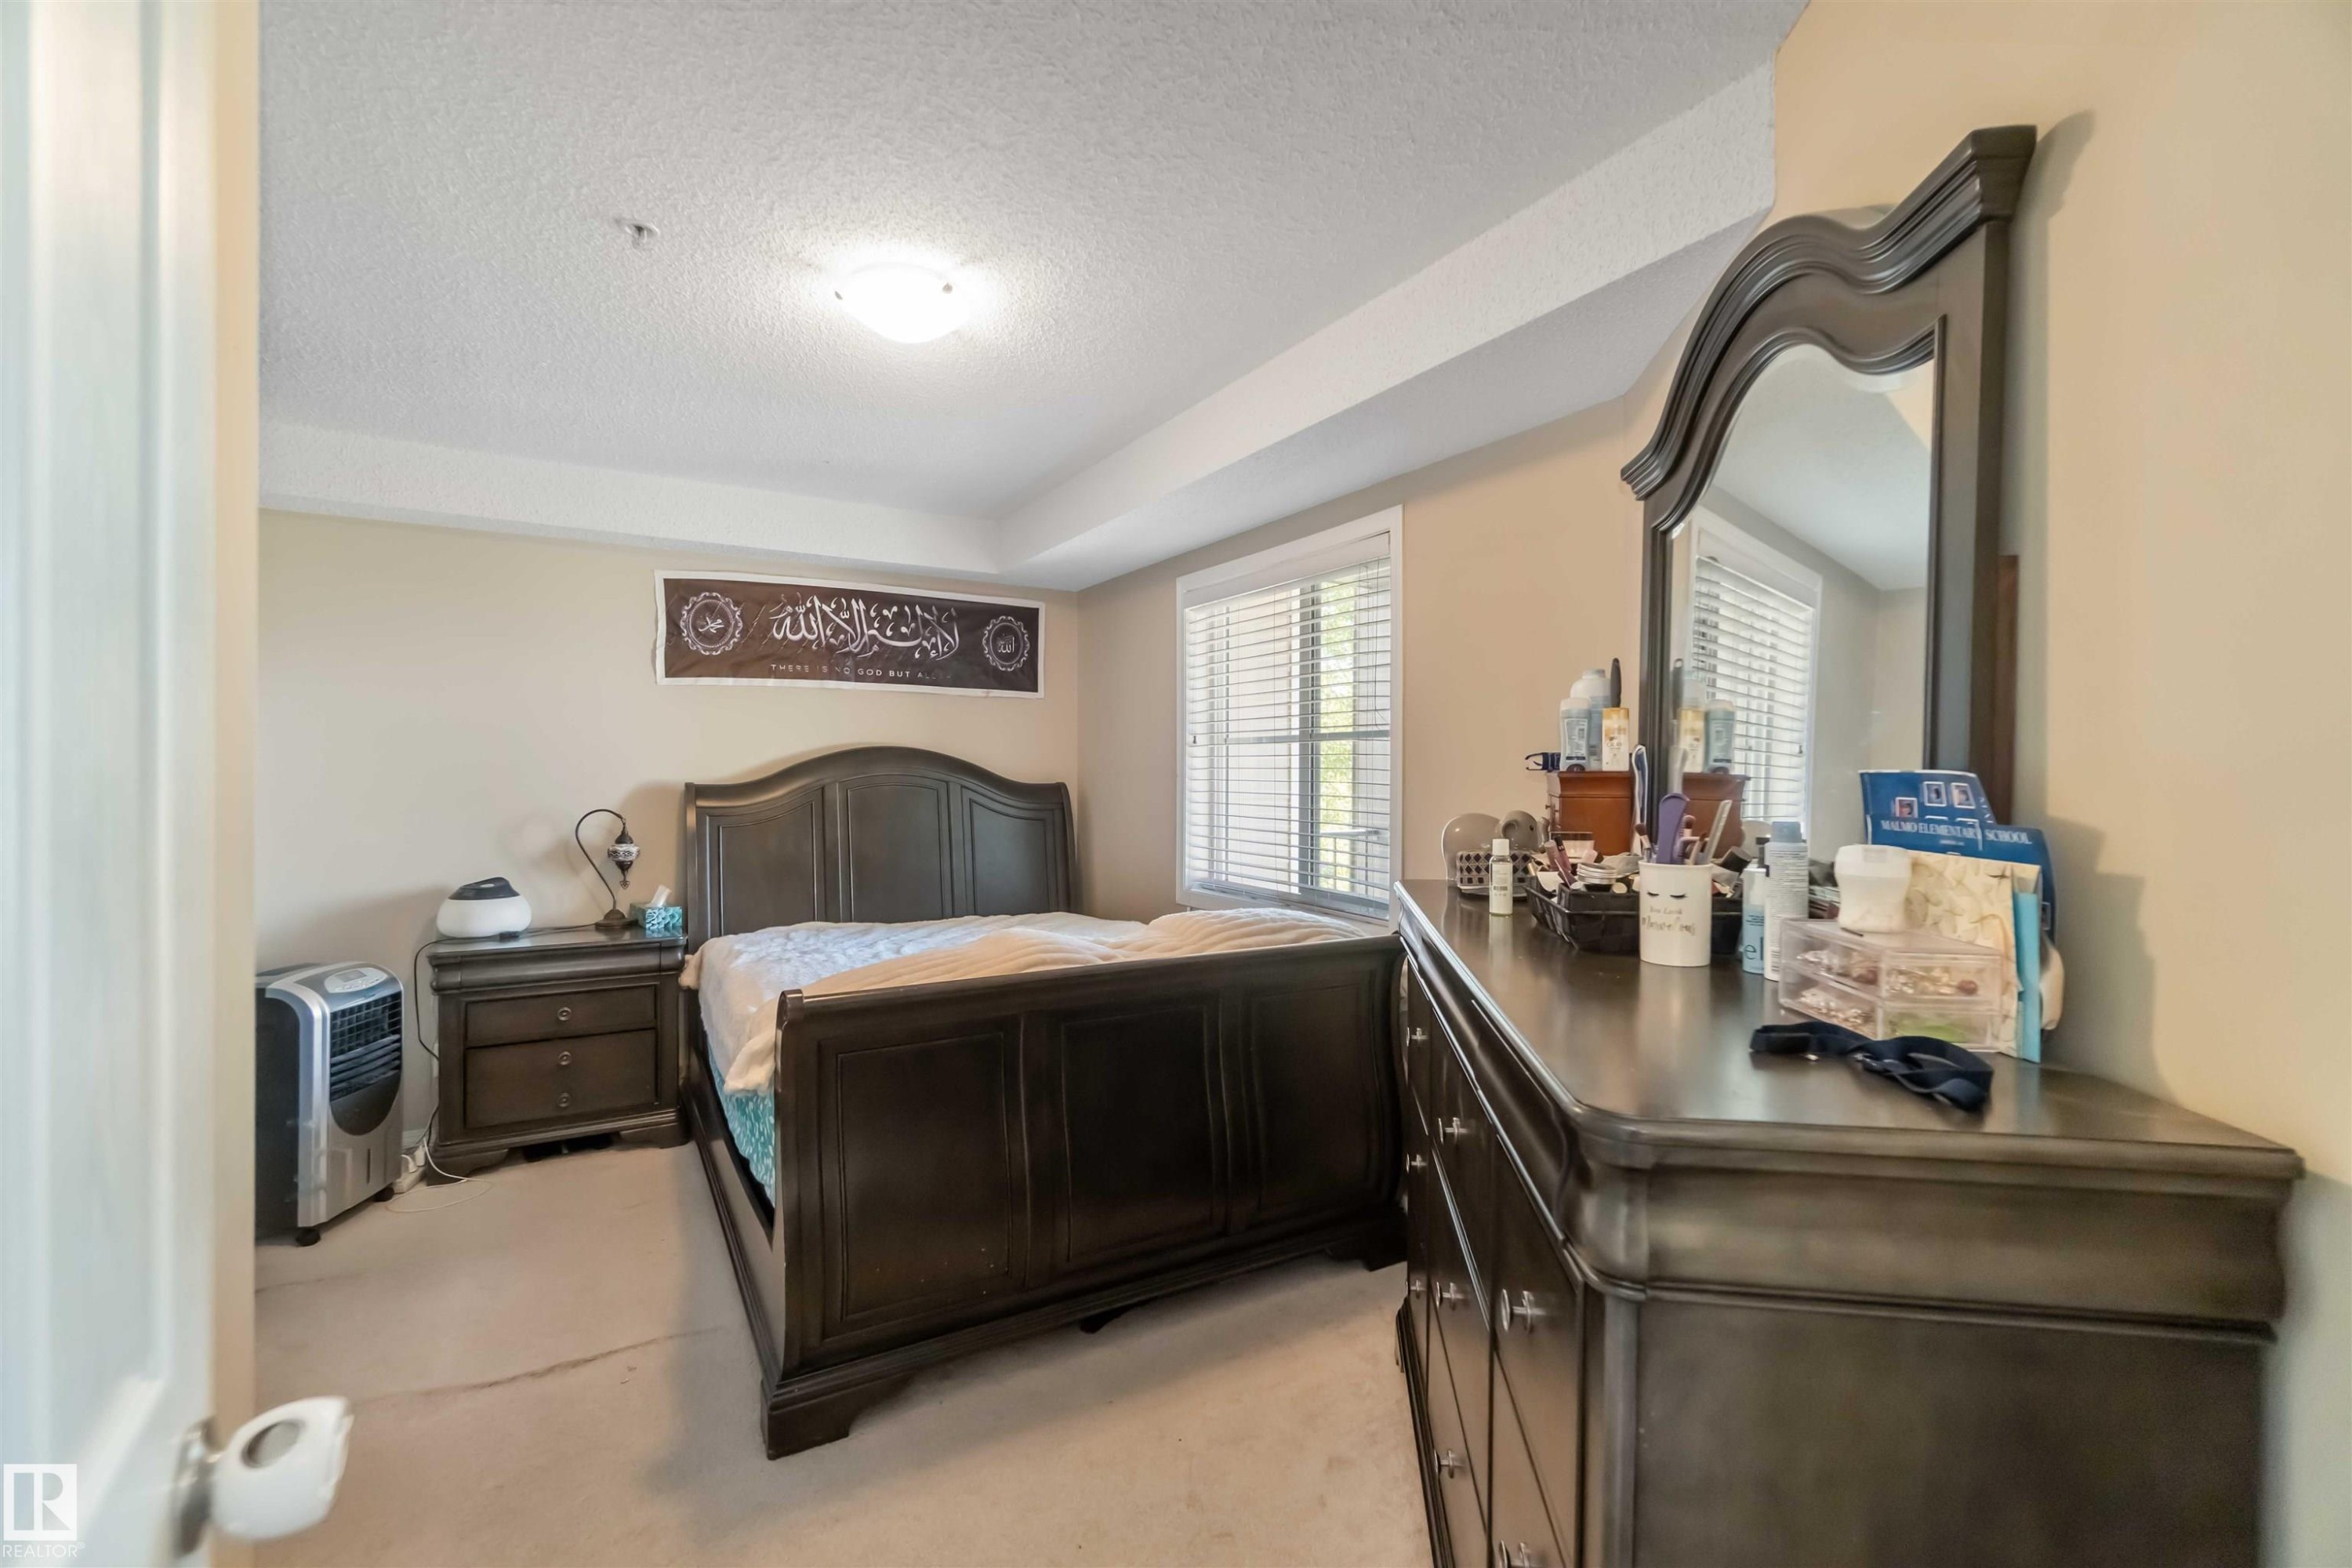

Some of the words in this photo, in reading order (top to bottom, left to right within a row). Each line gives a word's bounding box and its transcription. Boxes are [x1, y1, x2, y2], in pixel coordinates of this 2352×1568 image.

[770, 664, 809, 673] THERE
[834, 666, 851, 675] NO
[858, 668, 883, 677] GOD
[889, 670, 910, 678] BUT
[917, 671, 952, 681] ALL
[1881, 819, 1918, 833] MALMO
[1918, 822, 1981, 840] ELEMENTARY
[1984, 829, 2033, 845] SCHOOL
